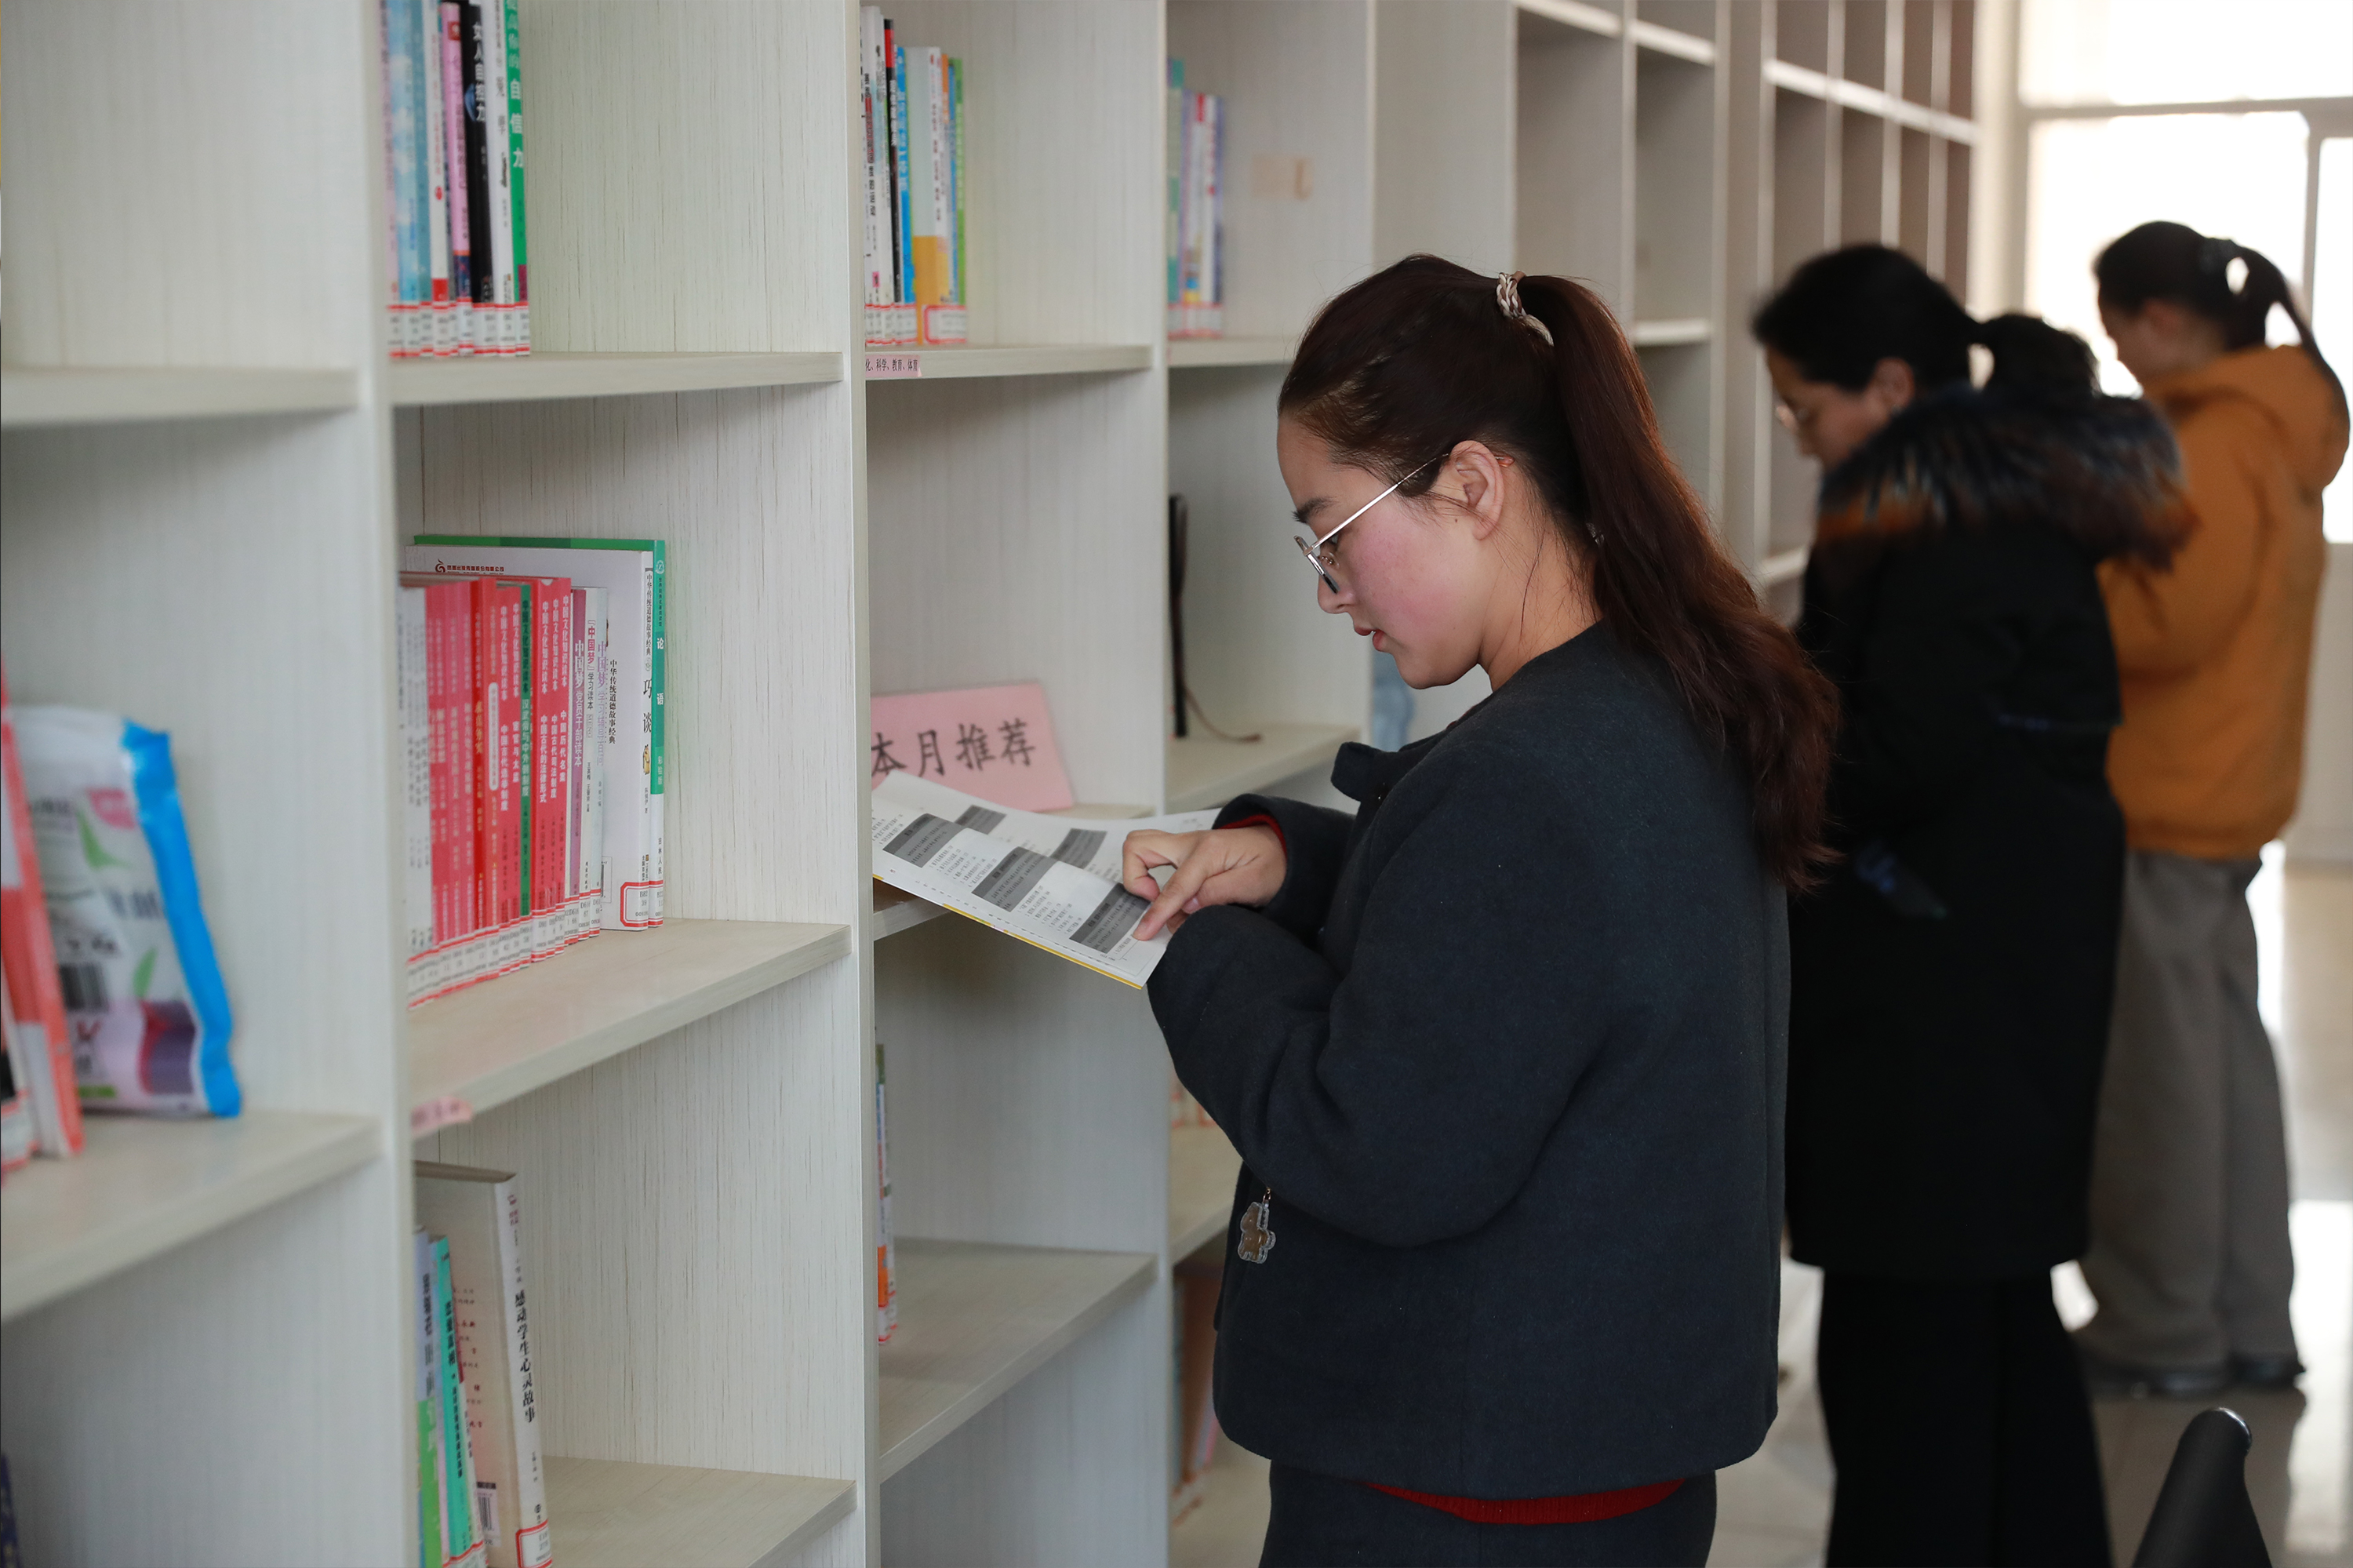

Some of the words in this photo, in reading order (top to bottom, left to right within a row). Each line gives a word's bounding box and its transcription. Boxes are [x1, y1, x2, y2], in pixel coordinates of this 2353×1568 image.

[511, 78, 524, 168] 自信力
[561, 595, 569, 687] 中国文化知识读本
[609, 659, 617, 744] 中华传统道德故事经典
[871, 718, 1036, 778] 本月推荐
[515, 1290, 536, 1424] 感动学生心灵故事
